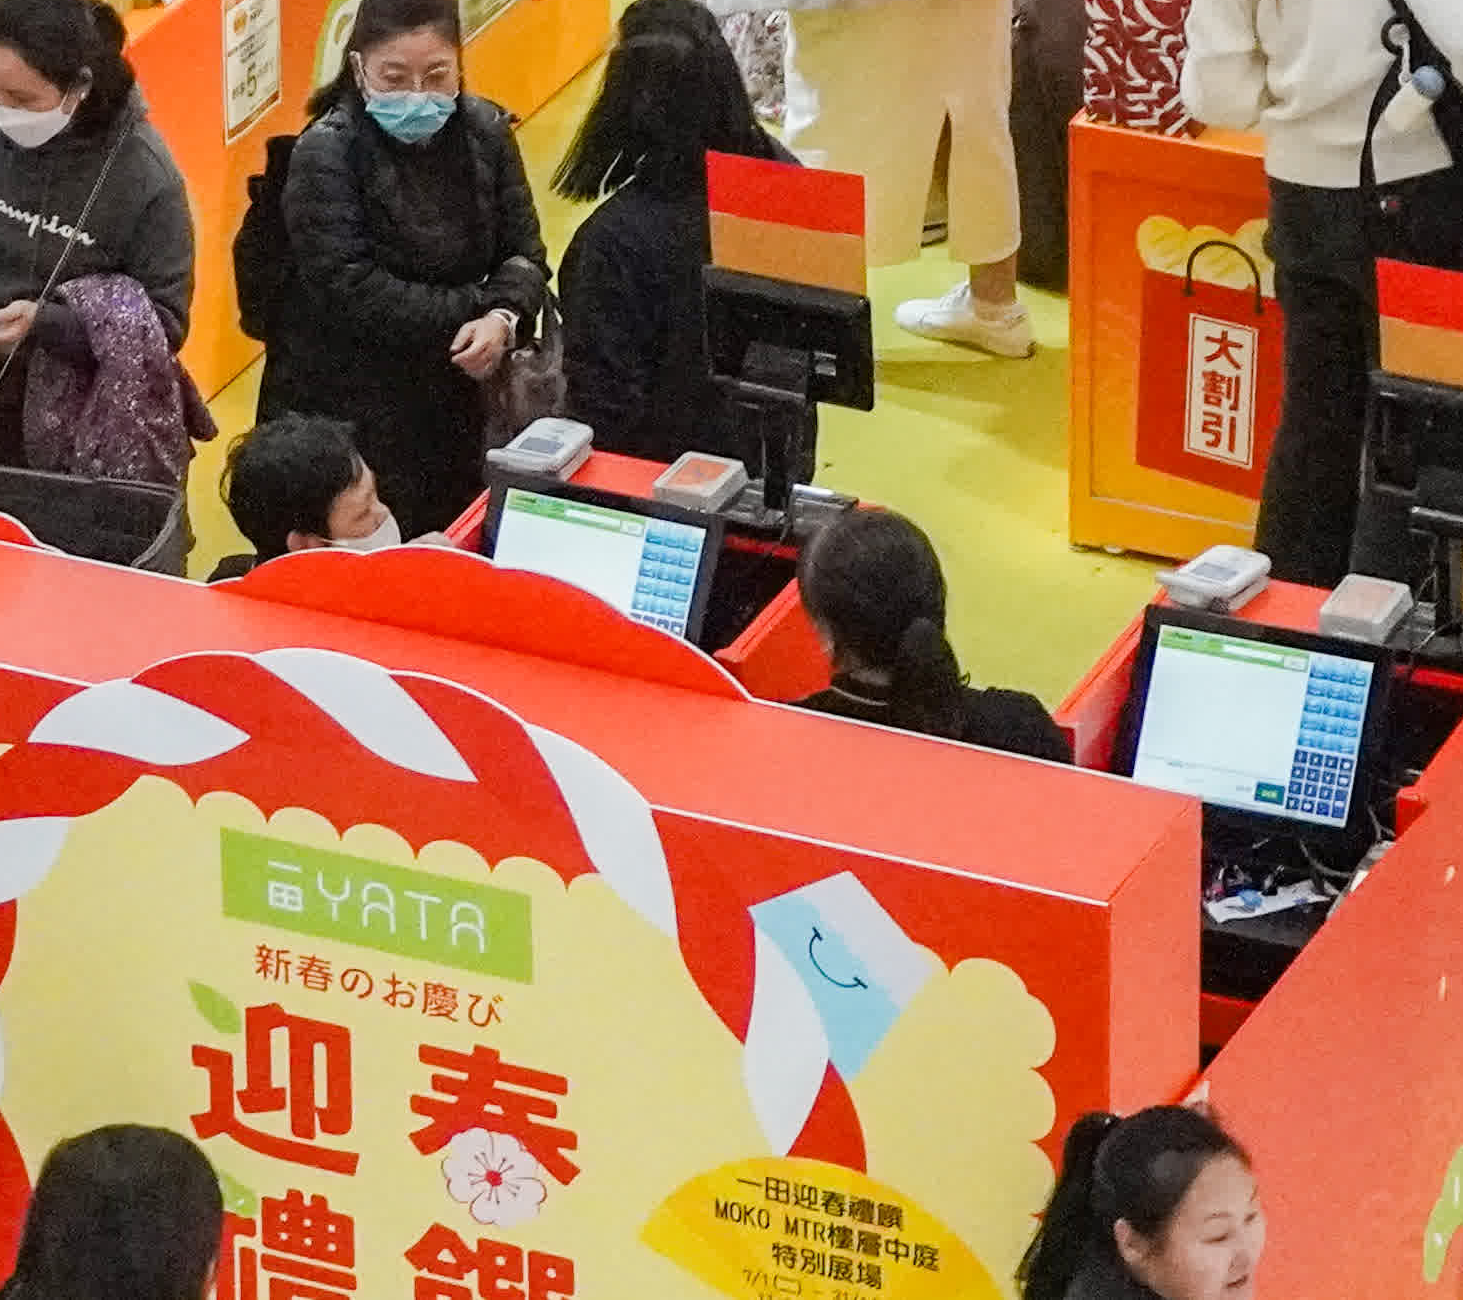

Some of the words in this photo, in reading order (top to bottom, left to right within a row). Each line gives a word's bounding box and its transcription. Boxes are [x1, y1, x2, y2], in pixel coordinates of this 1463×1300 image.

[1198, 322, 1248, 459] 大割引
[315, 870, 486, 954] YATA
[254, 942, 505, 1029] 新春のお慶び
[714, 1197, 771, 1231] MOKO
[771, 1241, 883, 1291] 特別展場
